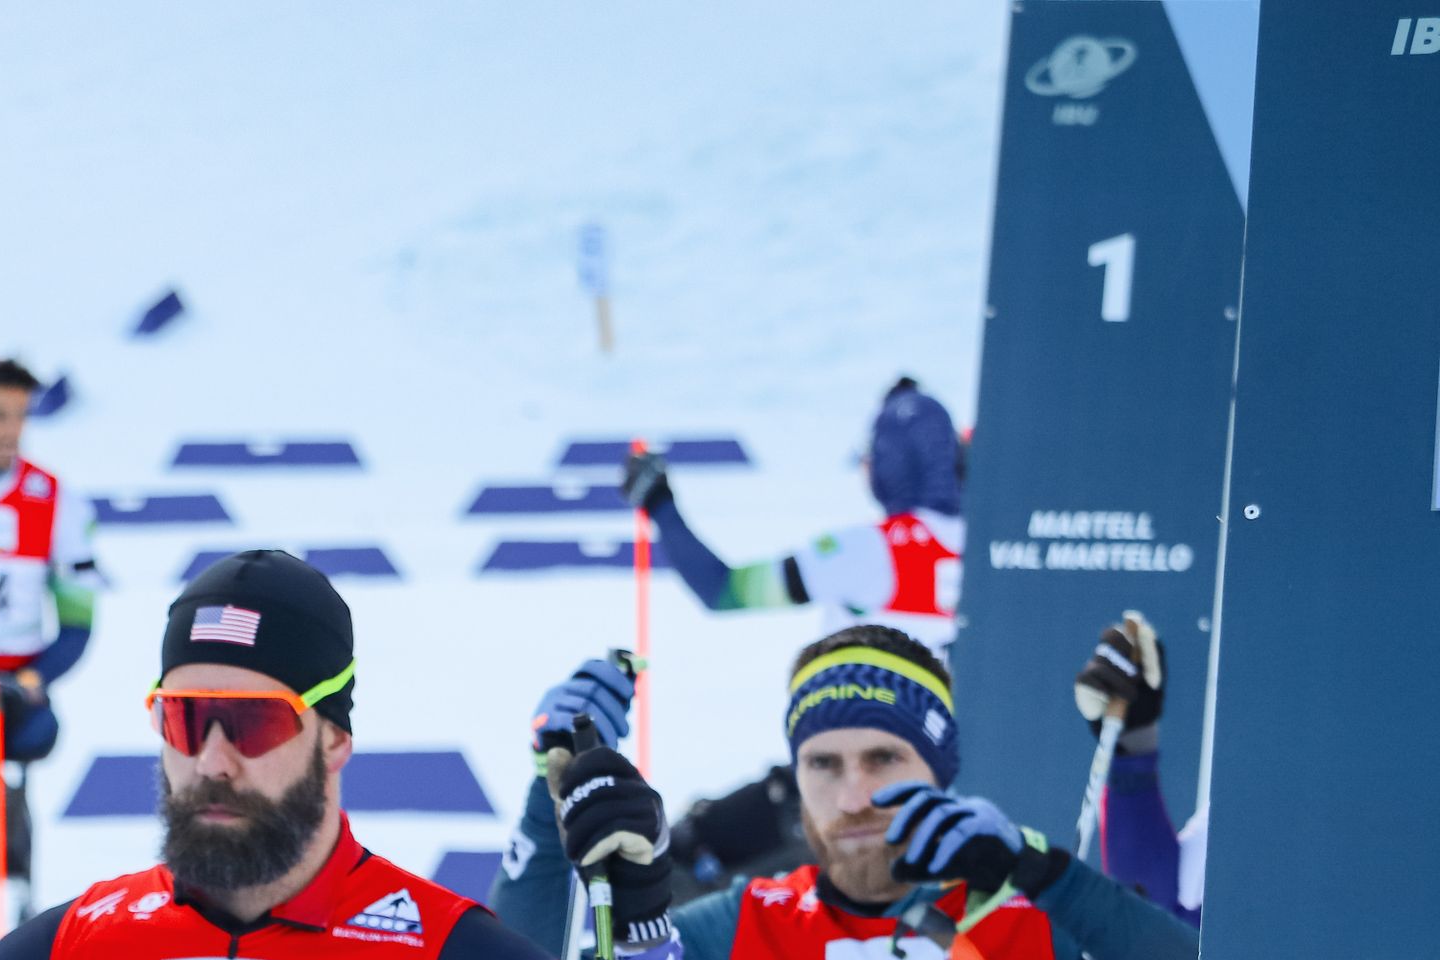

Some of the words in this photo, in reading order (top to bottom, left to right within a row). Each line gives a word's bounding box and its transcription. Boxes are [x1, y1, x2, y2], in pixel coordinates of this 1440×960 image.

[1087, 232, 1136, 322] 1
[1028, 509, 1155, 540] MARTELL
[990, 540, 1041, 570] VAL
[1045, 542, 1194, 572] MARTELLO
